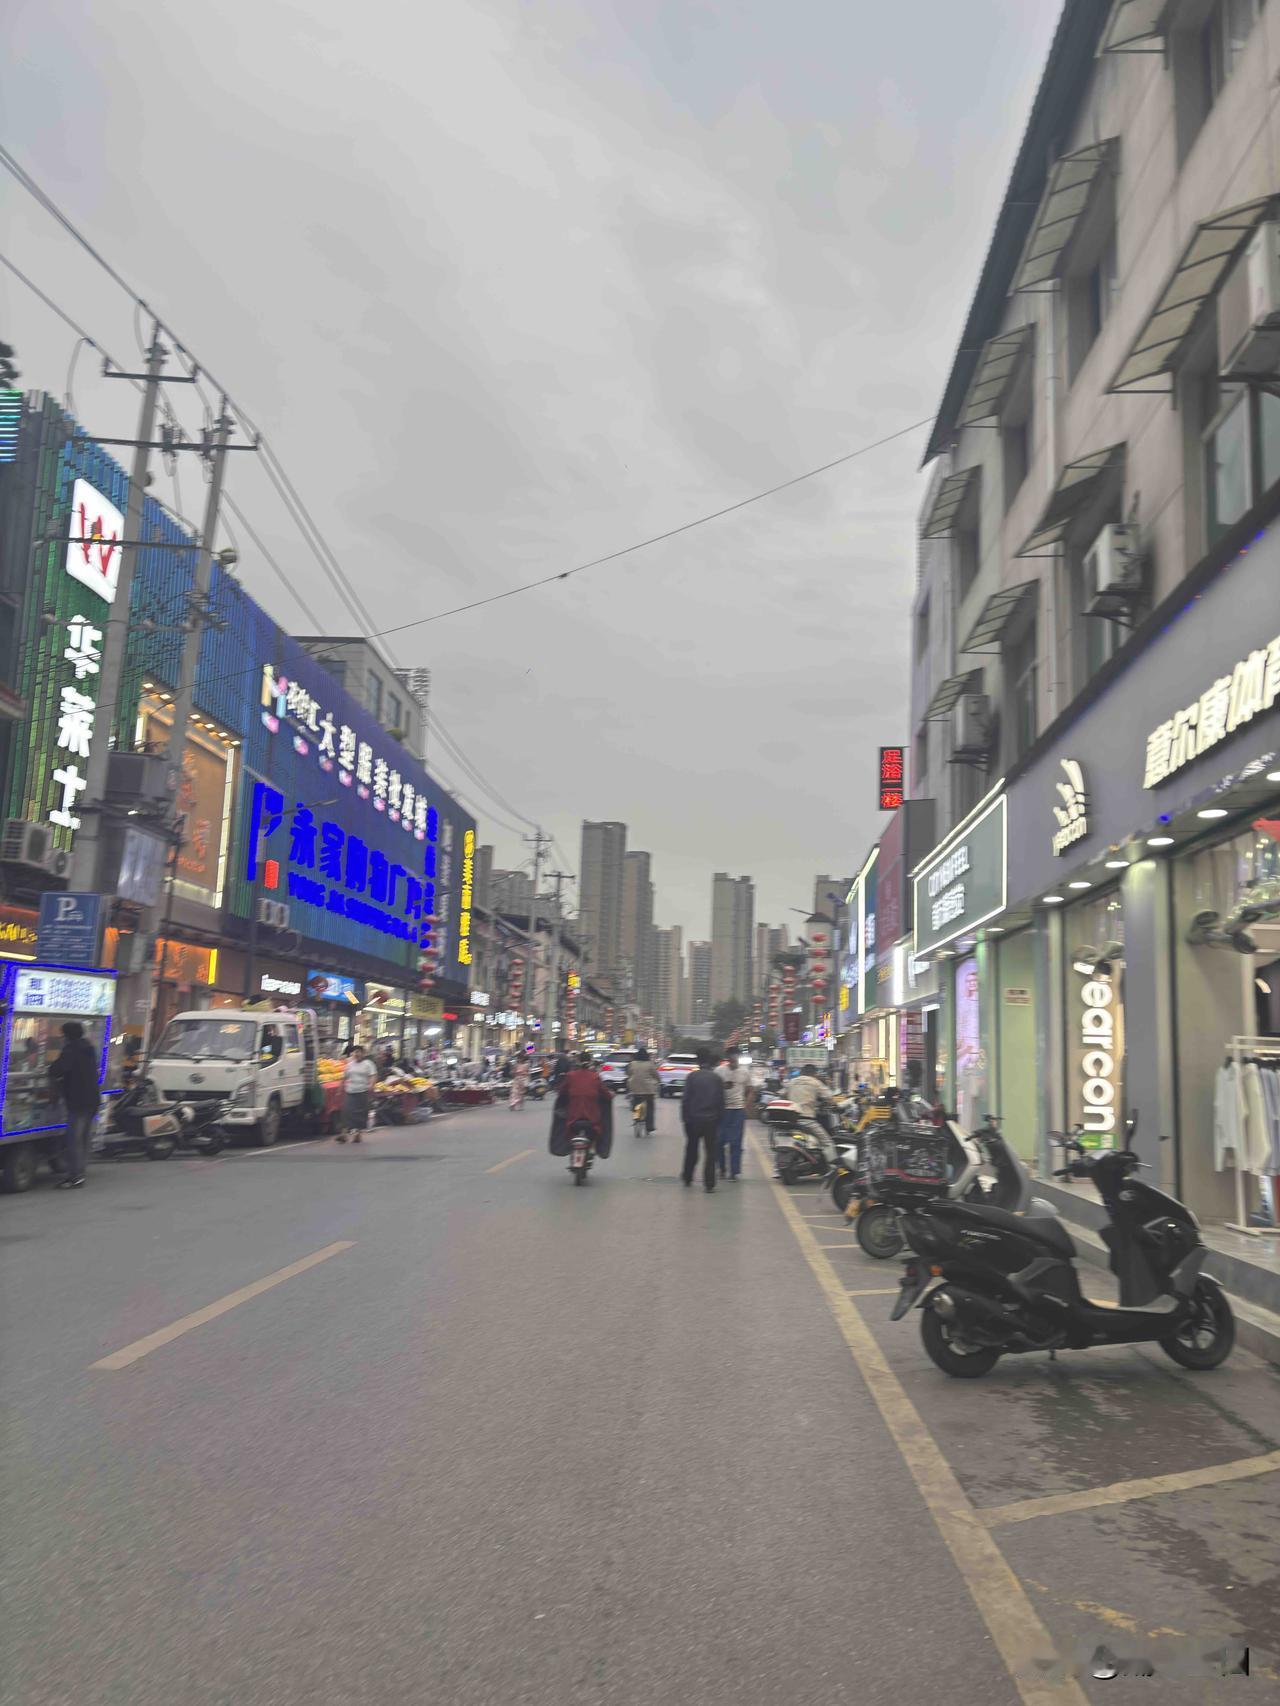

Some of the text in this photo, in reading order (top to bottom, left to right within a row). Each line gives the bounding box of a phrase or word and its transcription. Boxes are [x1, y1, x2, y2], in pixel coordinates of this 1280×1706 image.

[49, 615, 103, 830] 华莱士
[54, 897, 78, 921] P
